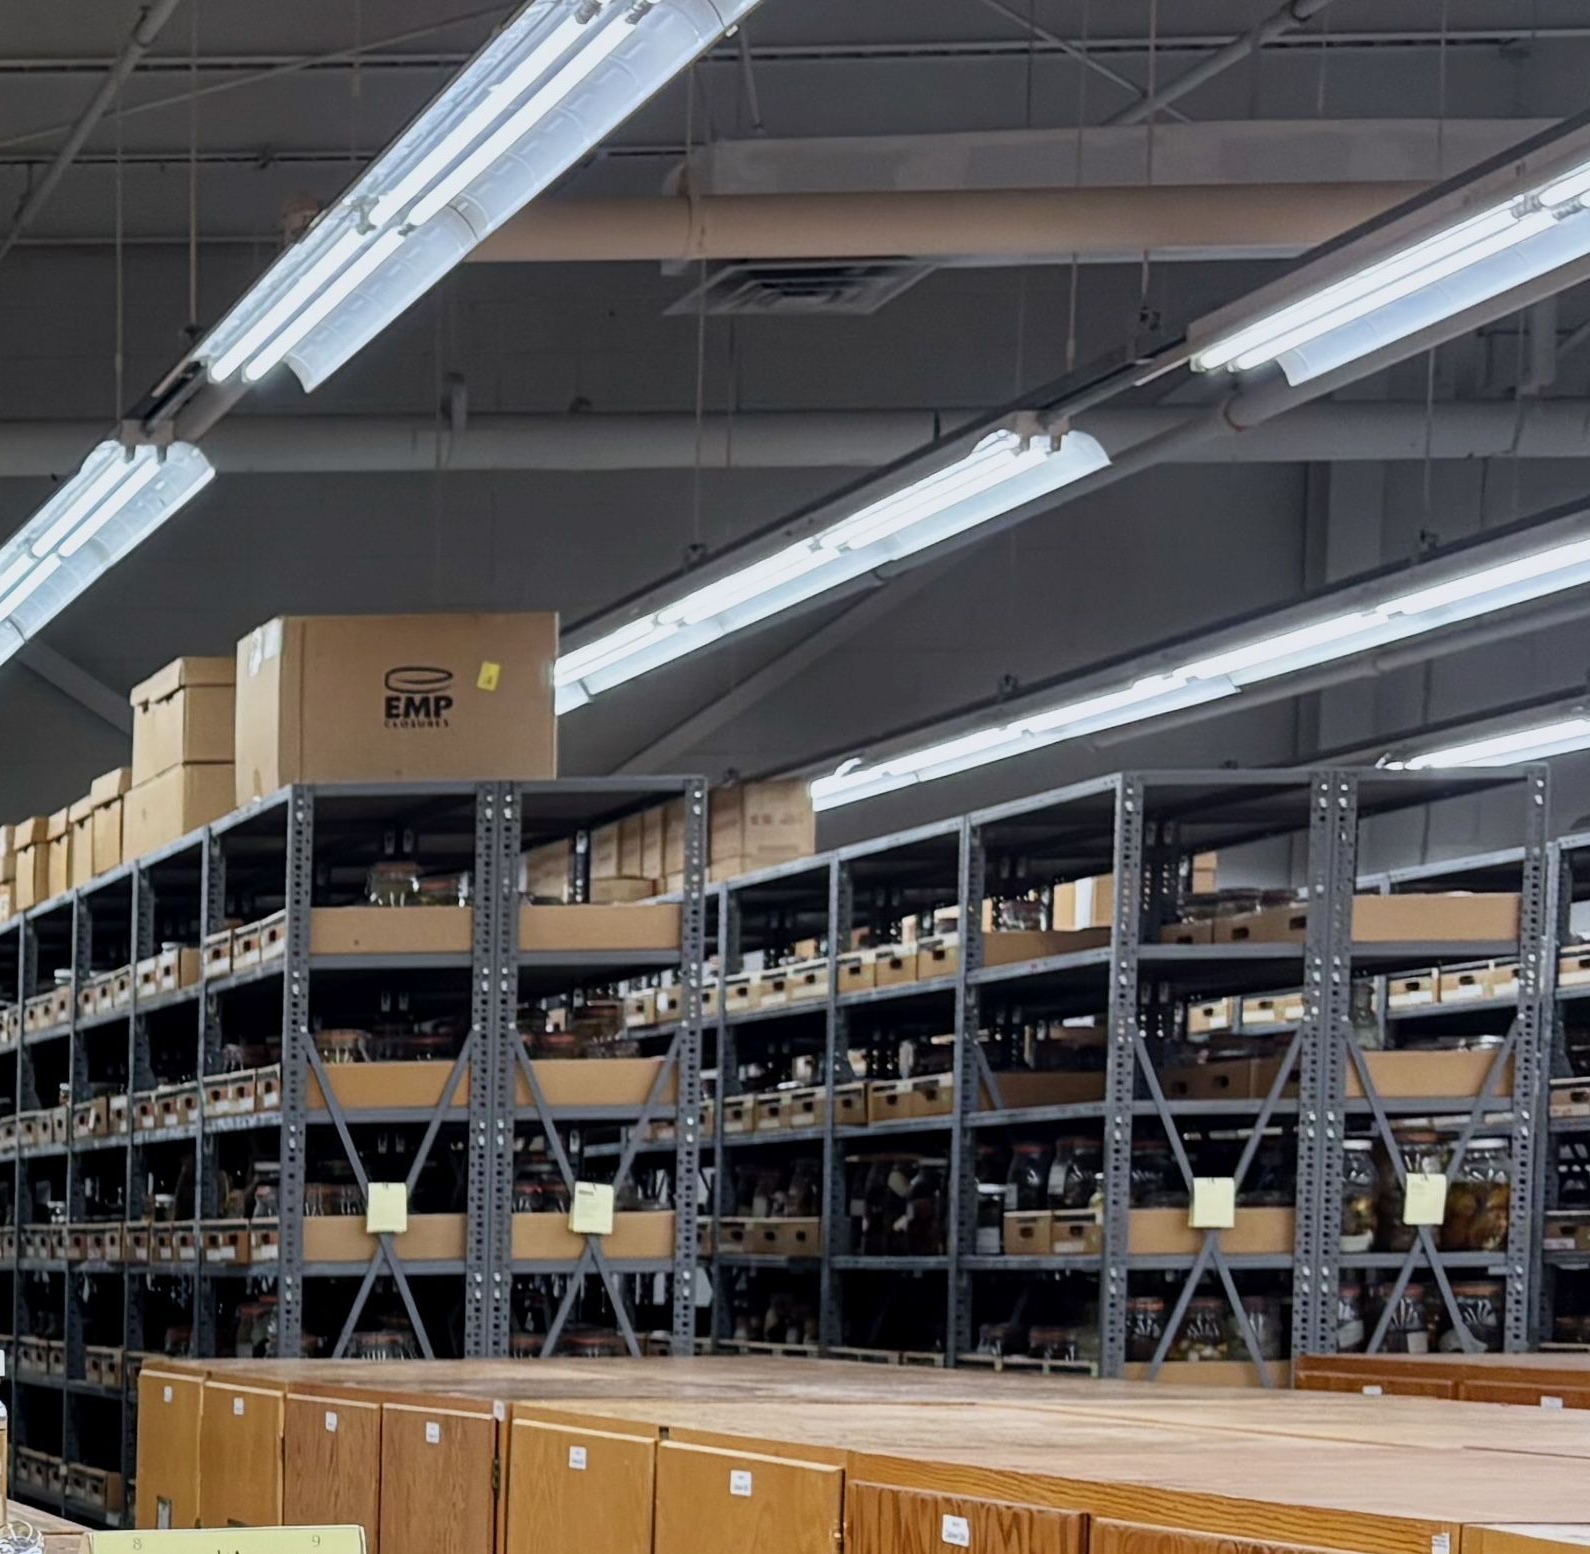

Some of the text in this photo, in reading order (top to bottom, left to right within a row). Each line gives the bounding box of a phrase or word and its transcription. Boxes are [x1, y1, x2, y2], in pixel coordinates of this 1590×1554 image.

[384, 694, 453, 719] EMP
[132, 1537, 142, 1551] 8
[311, 1535, 321, 1548] 9
